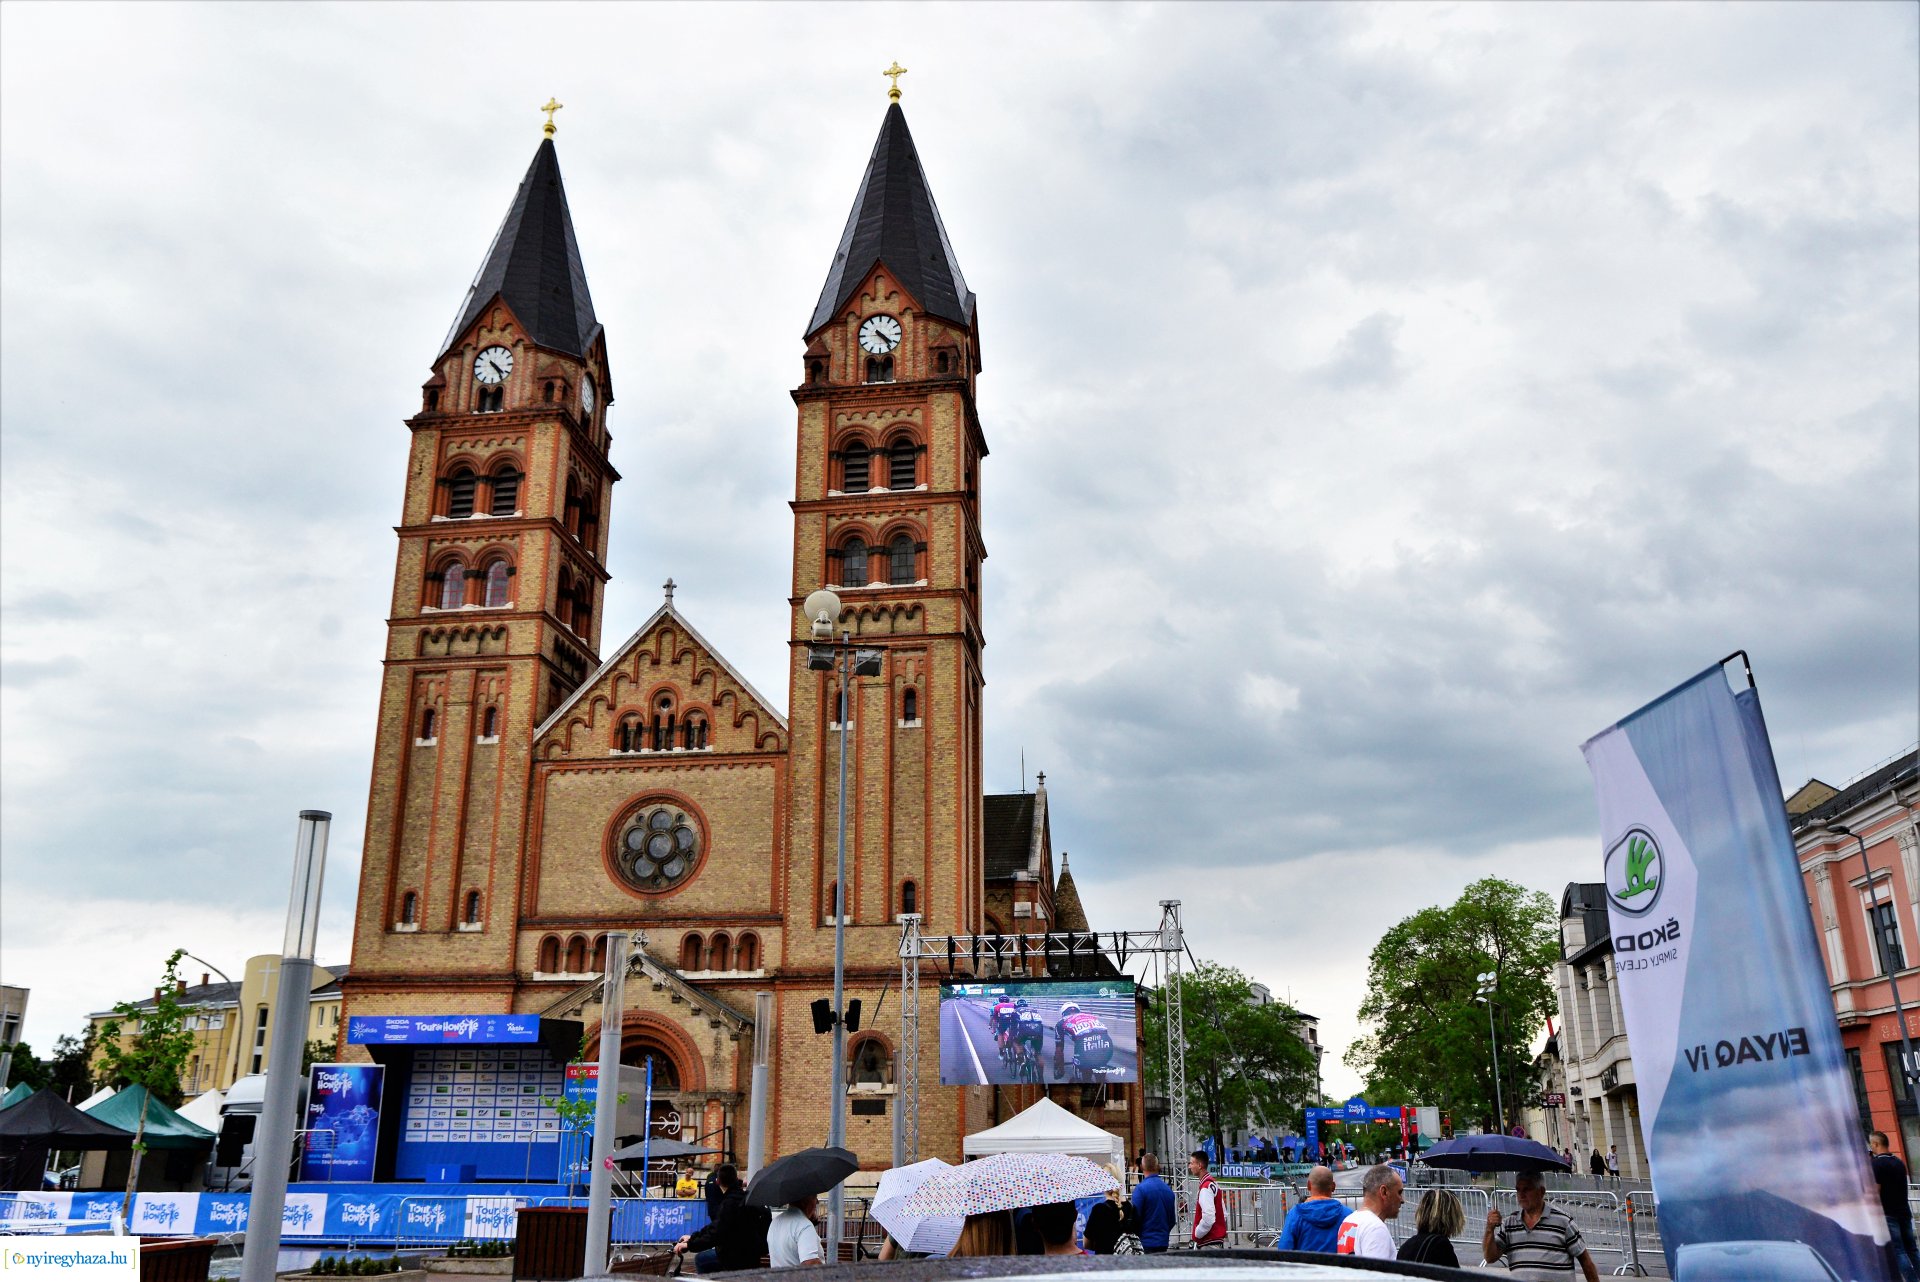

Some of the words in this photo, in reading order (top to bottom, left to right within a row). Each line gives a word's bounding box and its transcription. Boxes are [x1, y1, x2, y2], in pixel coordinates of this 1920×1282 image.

[415, 1021, 436, 1032] Tour
[443, 1019, 479, 1039] Hongrie
[1083, 1039, 1110, 1052] italia
[318, 1071, 340, 1080] Tour
[144, 1202, 167, 1213] Tour
[211, 1202, 234, 1213] Tour
[283, 1204, 301, 1213] our
[342, 1202, 366, 1213] Tour
[408, 1203, 432, 1214] Tour
[476, 1205, 500, 1216] Tour
[143, 1209, 180, 1229] Hongrie
[210, 1209, 248, 1229] Hongrie
[282, 1210, 313, 1231] ongrie
[342, 1209, 381, 1231] Hongrie
